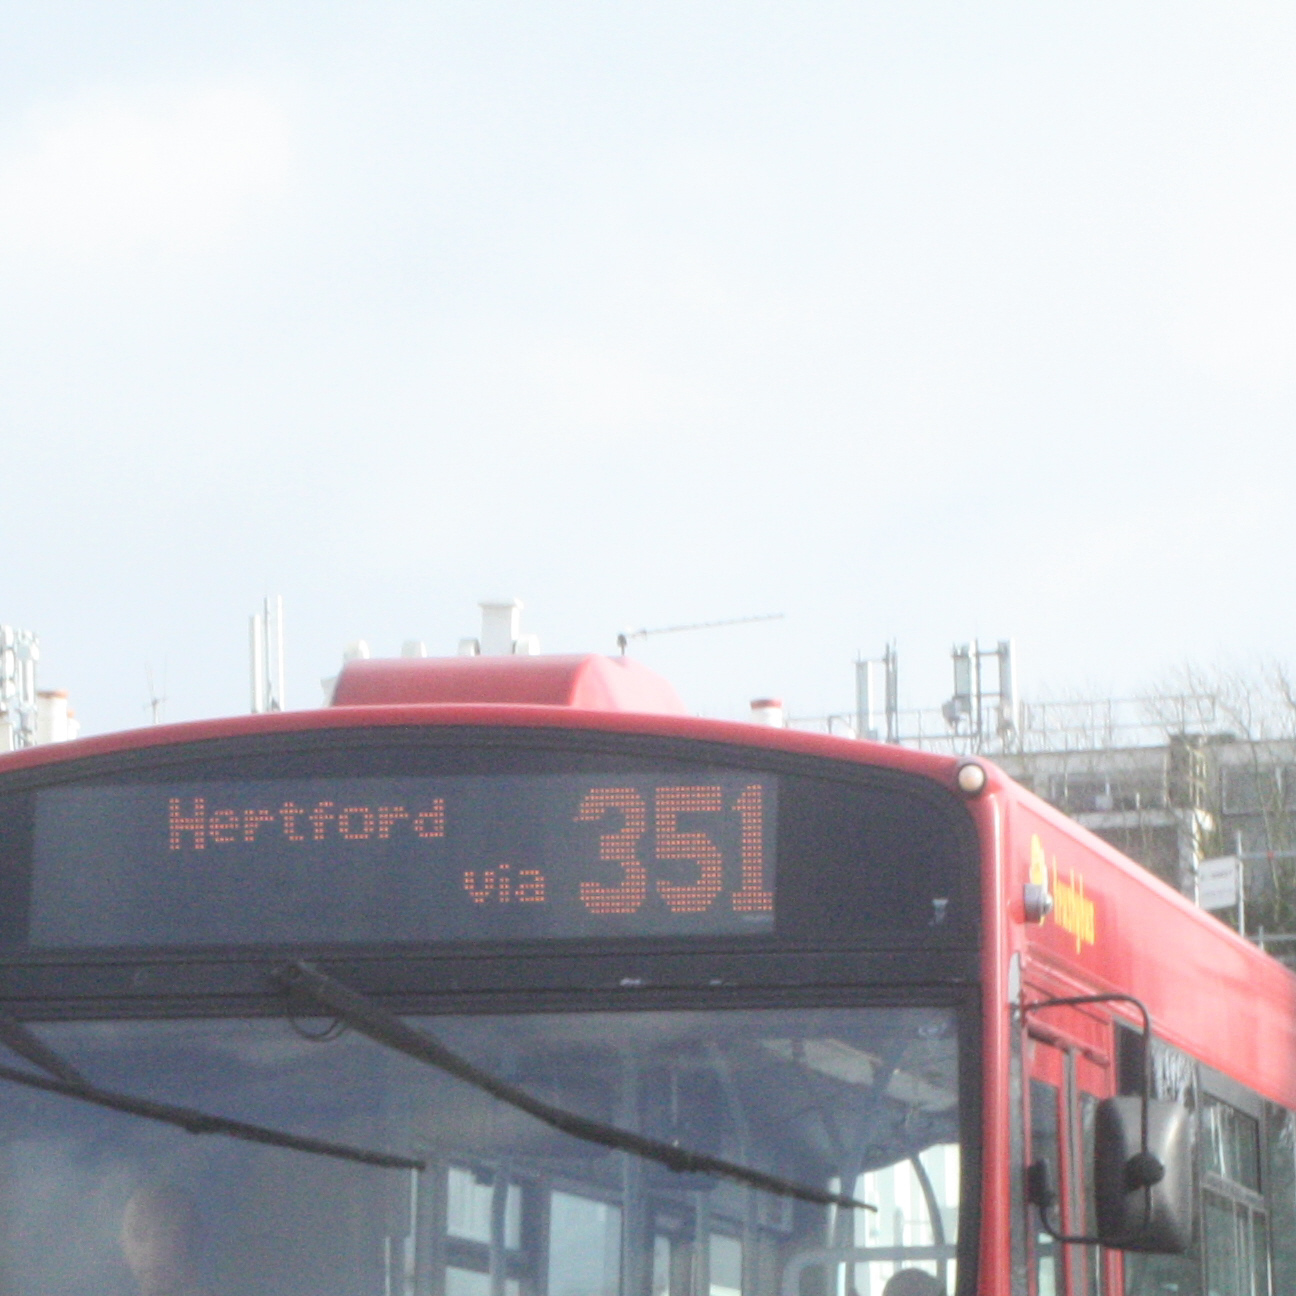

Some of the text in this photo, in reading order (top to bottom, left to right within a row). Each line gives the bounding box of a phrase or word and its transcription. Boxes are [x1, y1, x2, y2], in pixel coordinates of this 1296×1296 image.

[169, 798, 445, 850] Hertford
[573, 784, 773, 914] 351
[463, 863, 546, 903] via
